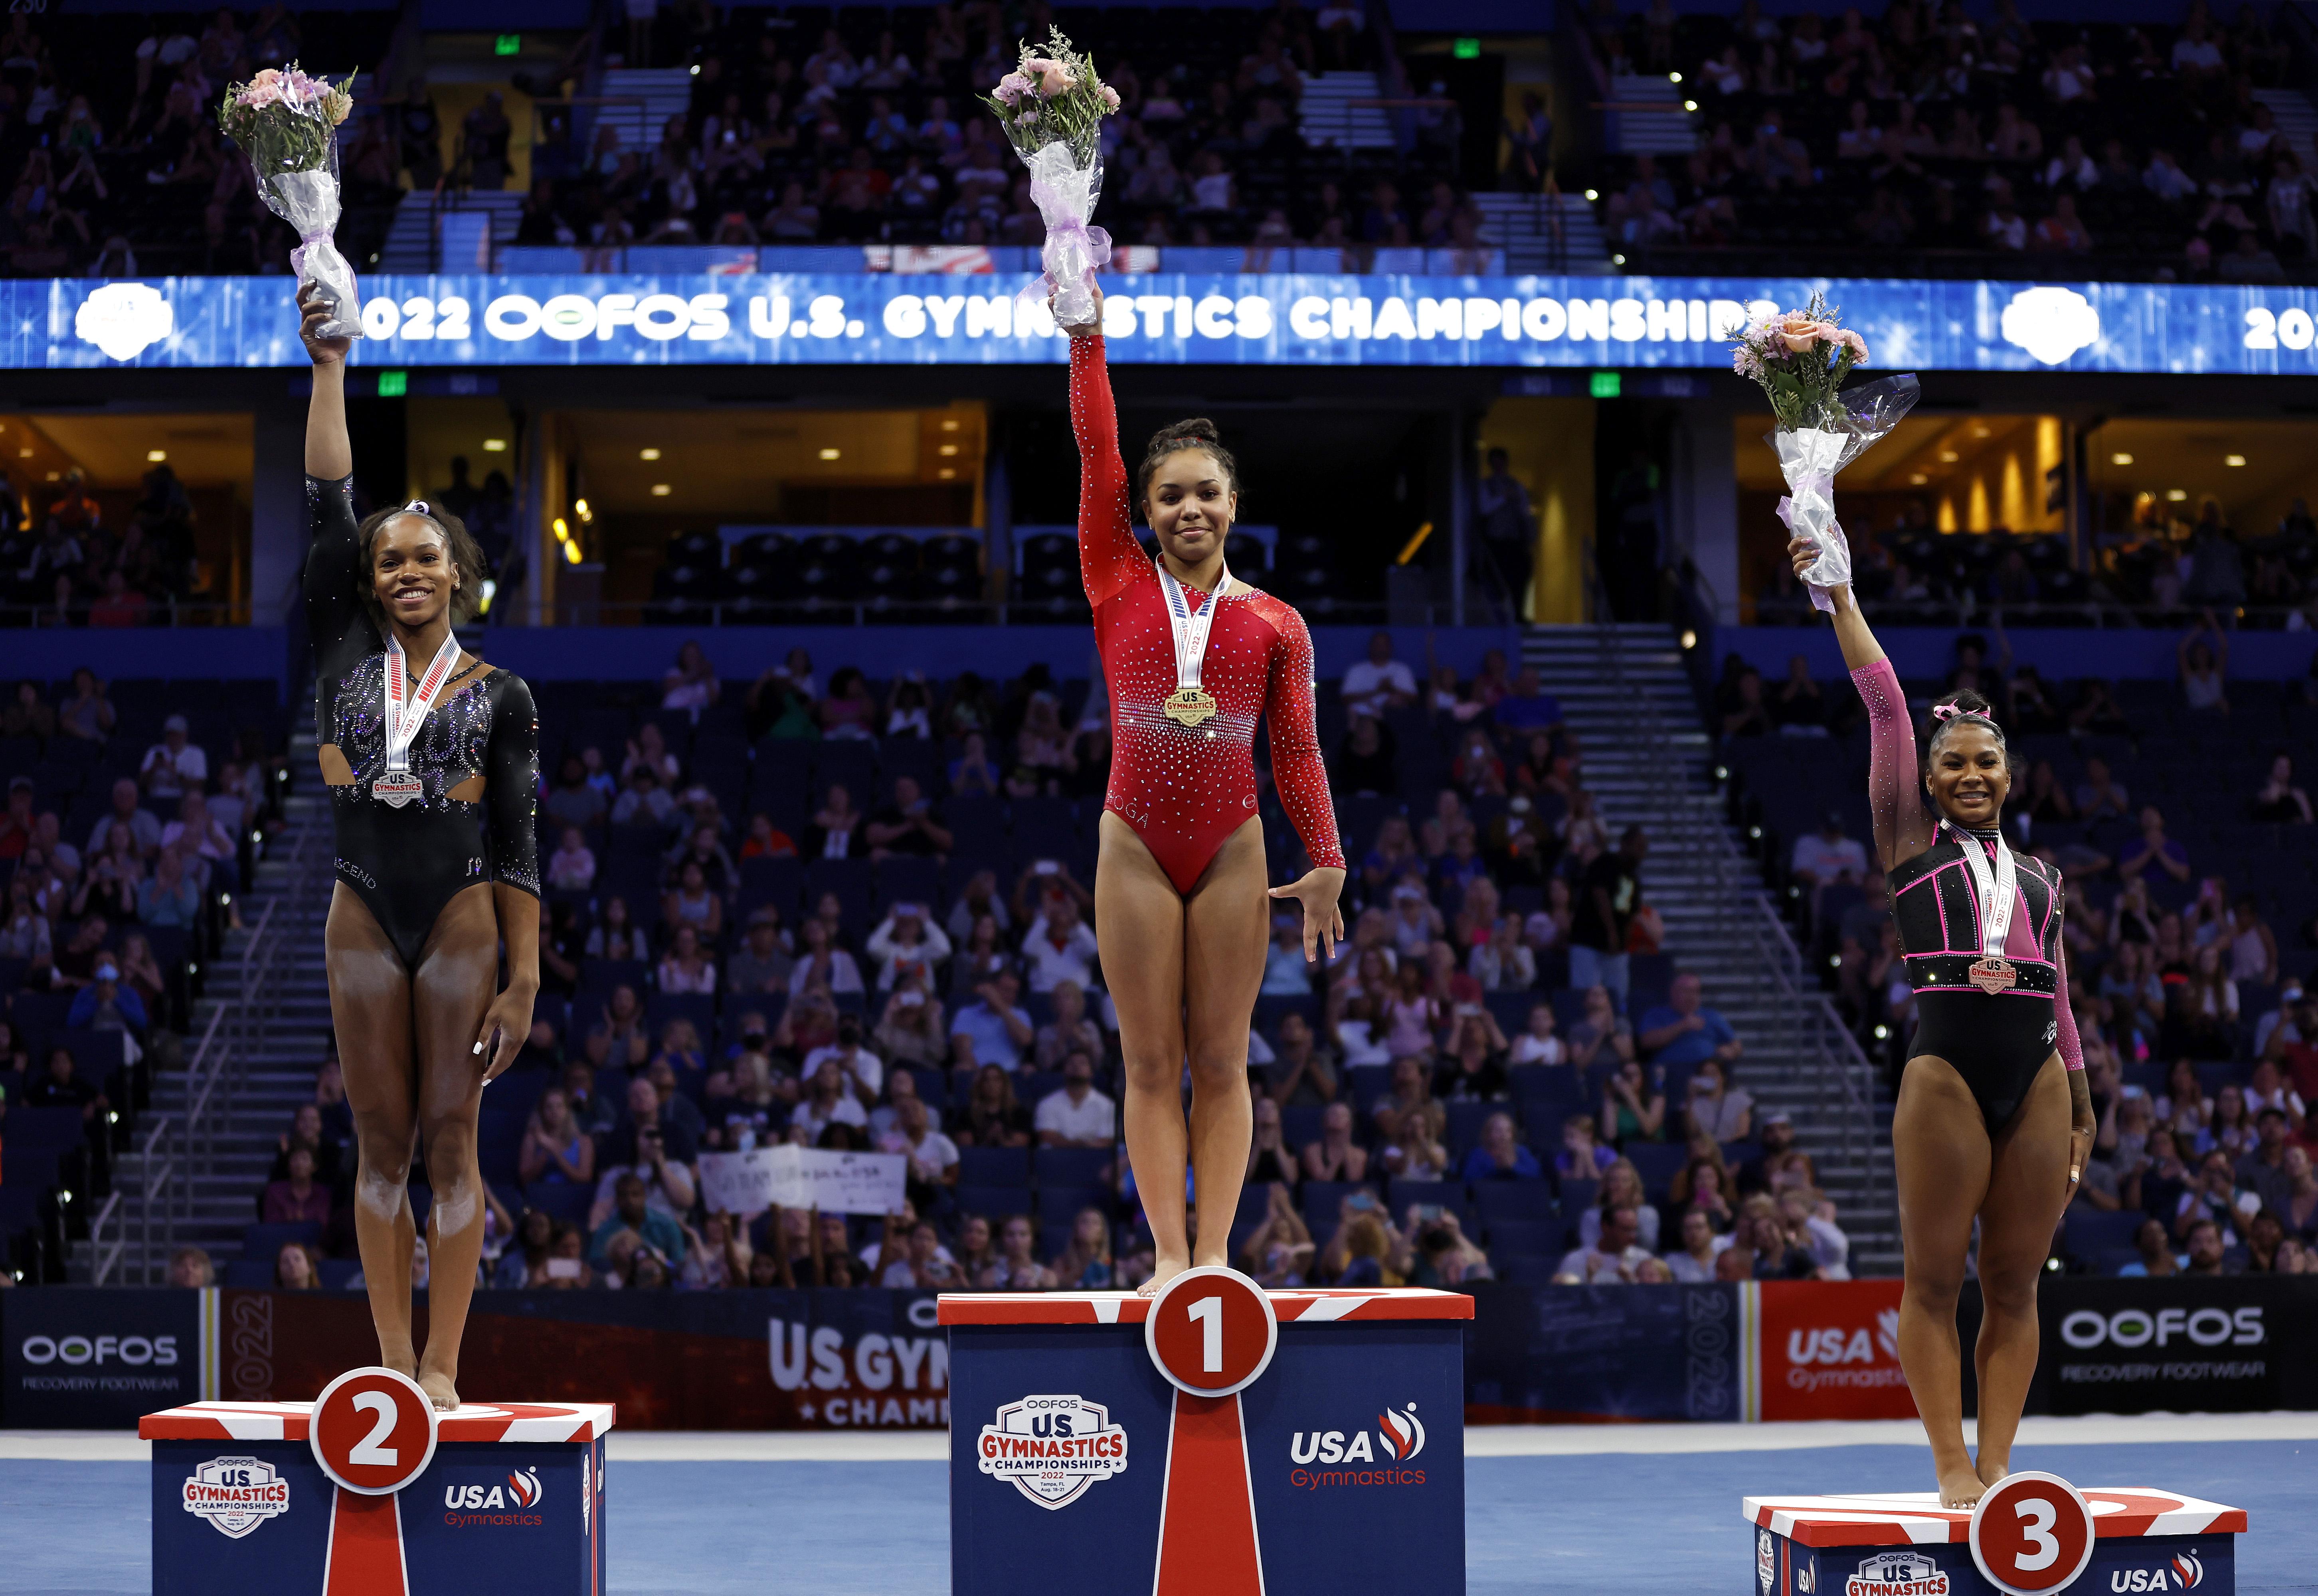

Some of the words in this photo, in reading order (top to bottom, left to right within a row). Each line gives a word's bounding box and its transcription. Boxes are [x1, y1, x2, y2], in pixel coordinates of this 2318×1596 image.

[360, 296, 470, 341] 022
[484, 294, 730, 341] OOFOS
[749, 295, 864, 338] U.S.
[883, 295, 1272, 339] GYMNSTICS
[2244, 307, 2318, 350] 20
[1190, 636, 1201, 654] 2022
[1167, 701, 1213, 709] GYMNASTICS
[1183, 692, 1198, 702] U.S.
[401, 719, 415, 737] 2022
[375, 783, 421, 791] GYMNASTICS
[390, 774, 405, 784] U.S.
[1996, 910, 2005, 927] 2022
[1972, 968, 2015, 979] GYMNASTICS
[1987, 960, 2001, 970] U.S.
[1187, 1297, 1222, 1372] 1
[2060, 1306, 2265, 1349] OOFOS
[22, 1336, 178, 1365] OOFOS
[769, 1317, 851, 1392] U.S.
[1685, 1290, 1729, 1419] 2022
[1788, 1328, 1875, 1365] USA
[23, 1376, 97, 1391] RECOVERY
[100, 1376, 179, 1391] FOOTWEAR
[1787, 1367, 1908, 1393] Gymnasti
[2061, 1363, 2158, 1383] RECOVERY
[2162, 1361, 2266, 1381] FOOTWEAR
[1027, 1400, 1078, 1408] OOFOS
[349, 1391, 398, 1466] 2
[1032, 1413, 1074, 1438] U.S.
[983, 1434, 1123, 1458] GYMNASTICS
[1291, 1431, 1374, 1464] USA
[995, 1460, 1111, 1469] CHAMPIONSHIPS
[222, 1470, 251, 1487] U.S.
[1290, 1466, 1426, 1490] Gymnastics
[187, 1484, 285, 1501] GYMNASTICS
[445, 1485, 505, 1509] USA
[444, 1512, 542, 1528] Gymnastics
[2014, 1498, 2060, 1571] 3
[1799, 1568, 1810, 1594] USA
[1883, 1564, 1913, 1582] U.S.
[2111, 1569, 2168, 1593] USA
[1849, 1577, 1946, 1596] GYMNASTICS
